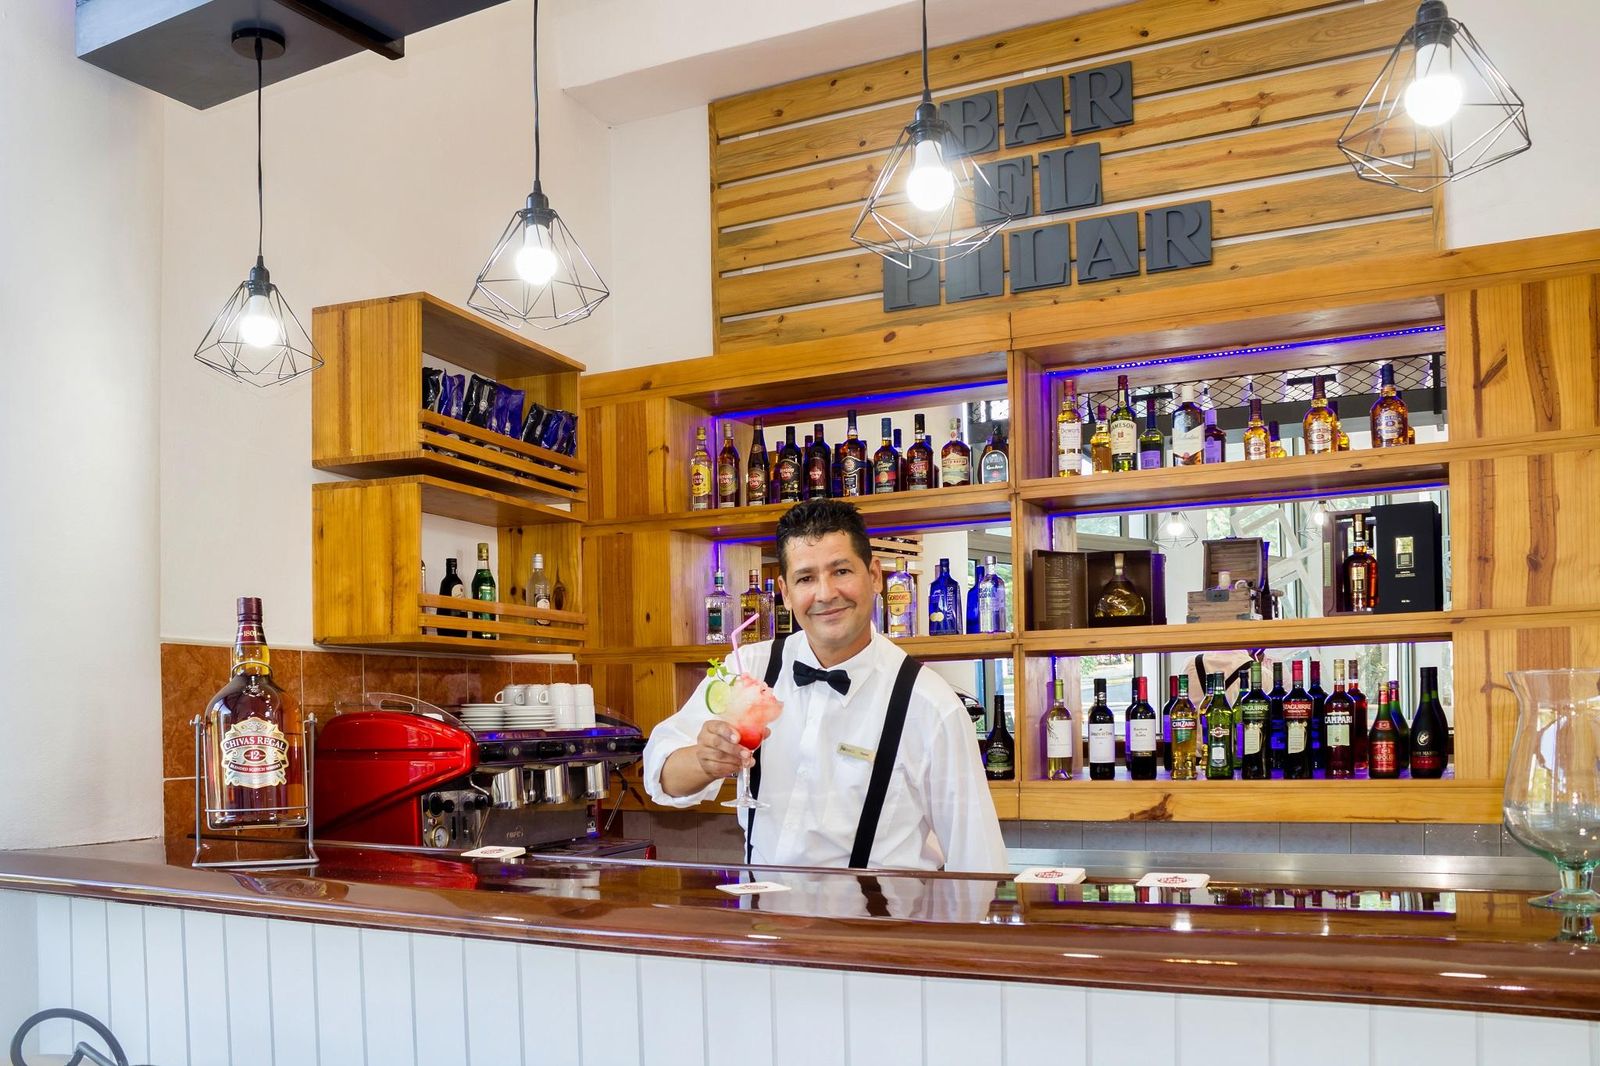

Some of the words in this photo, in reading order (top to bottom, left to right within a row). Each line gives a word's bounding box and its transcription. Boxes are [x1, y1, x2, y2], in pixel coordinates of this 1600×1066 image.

[941, 70, 1133, 157] BAR
[977, 150, 1100, 221] EL
[885, 209, 1211, 309] PILAR
[224, 736, 255, 750] CHIVAS
[257, 736, 285, 750] REGAL
[249, 750, 260, 760] 12
